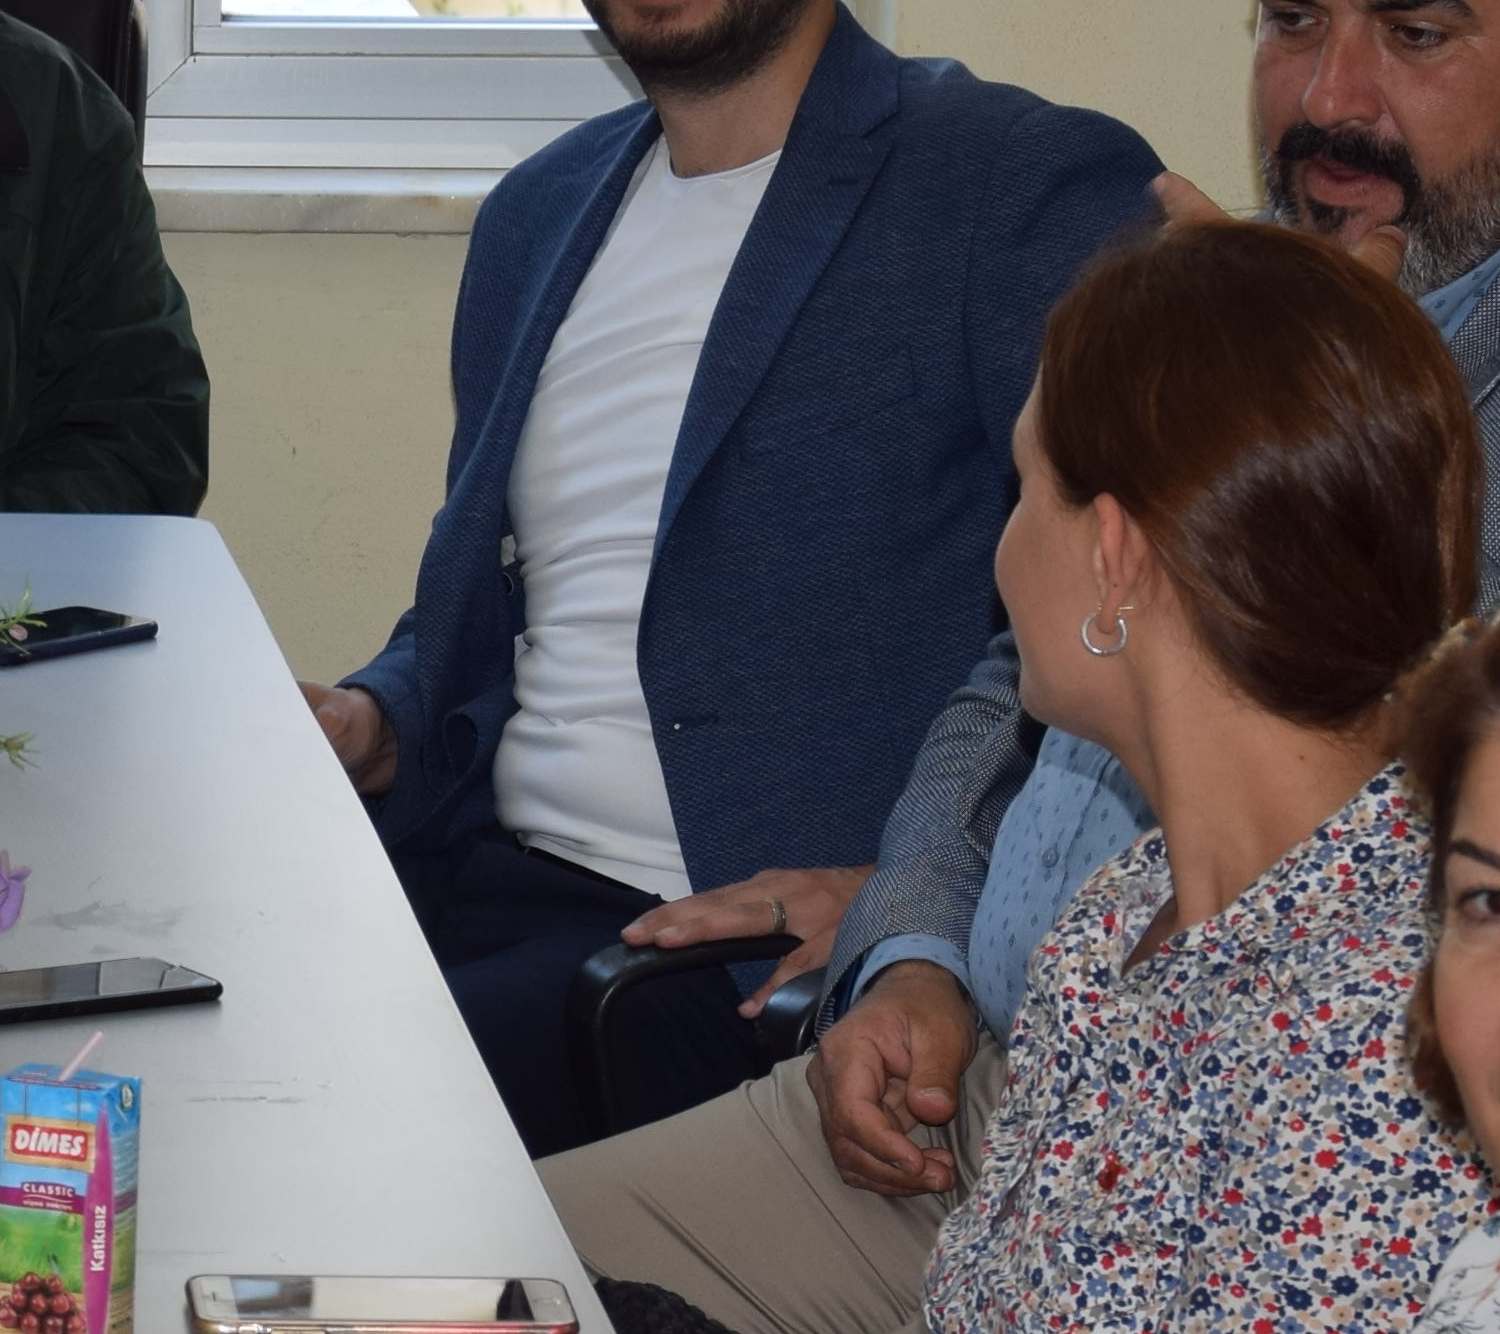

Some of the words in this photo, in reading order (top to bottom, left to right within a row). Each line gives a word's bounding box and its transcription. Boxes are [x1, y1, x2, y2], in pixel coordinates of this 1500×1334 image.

[13, 1125, 85, 1159] DİMES
[22, 1181, 75, 1199] CLASSIC
[90, 1205, 108, 1272] Katkısız
